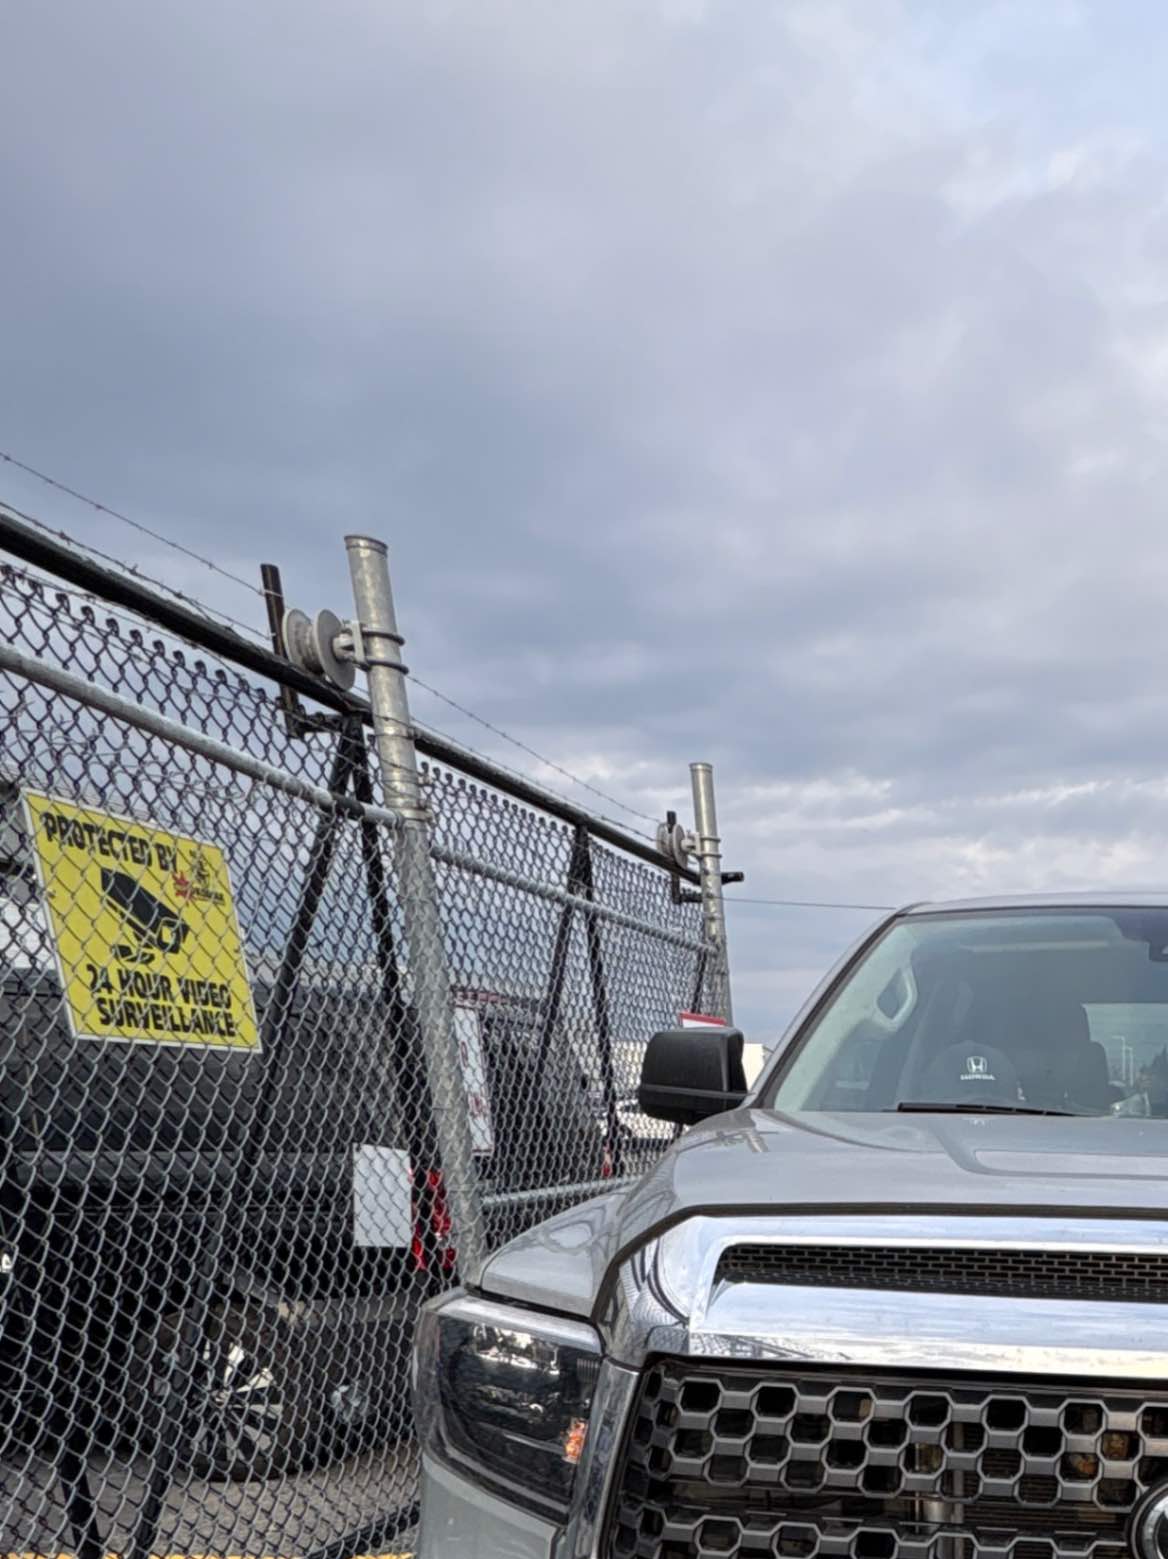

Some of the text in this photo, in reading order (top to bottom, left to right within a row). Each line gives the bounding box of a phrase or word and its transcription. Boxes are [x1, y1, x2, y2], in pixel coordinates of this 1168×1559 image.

[39, 811, 178, 872] PROTECTED BY
[85, 963, 231, 1010] 24 HOUR VIDEO
[96, 1000, 236, 1037] SURVEILLANCE
